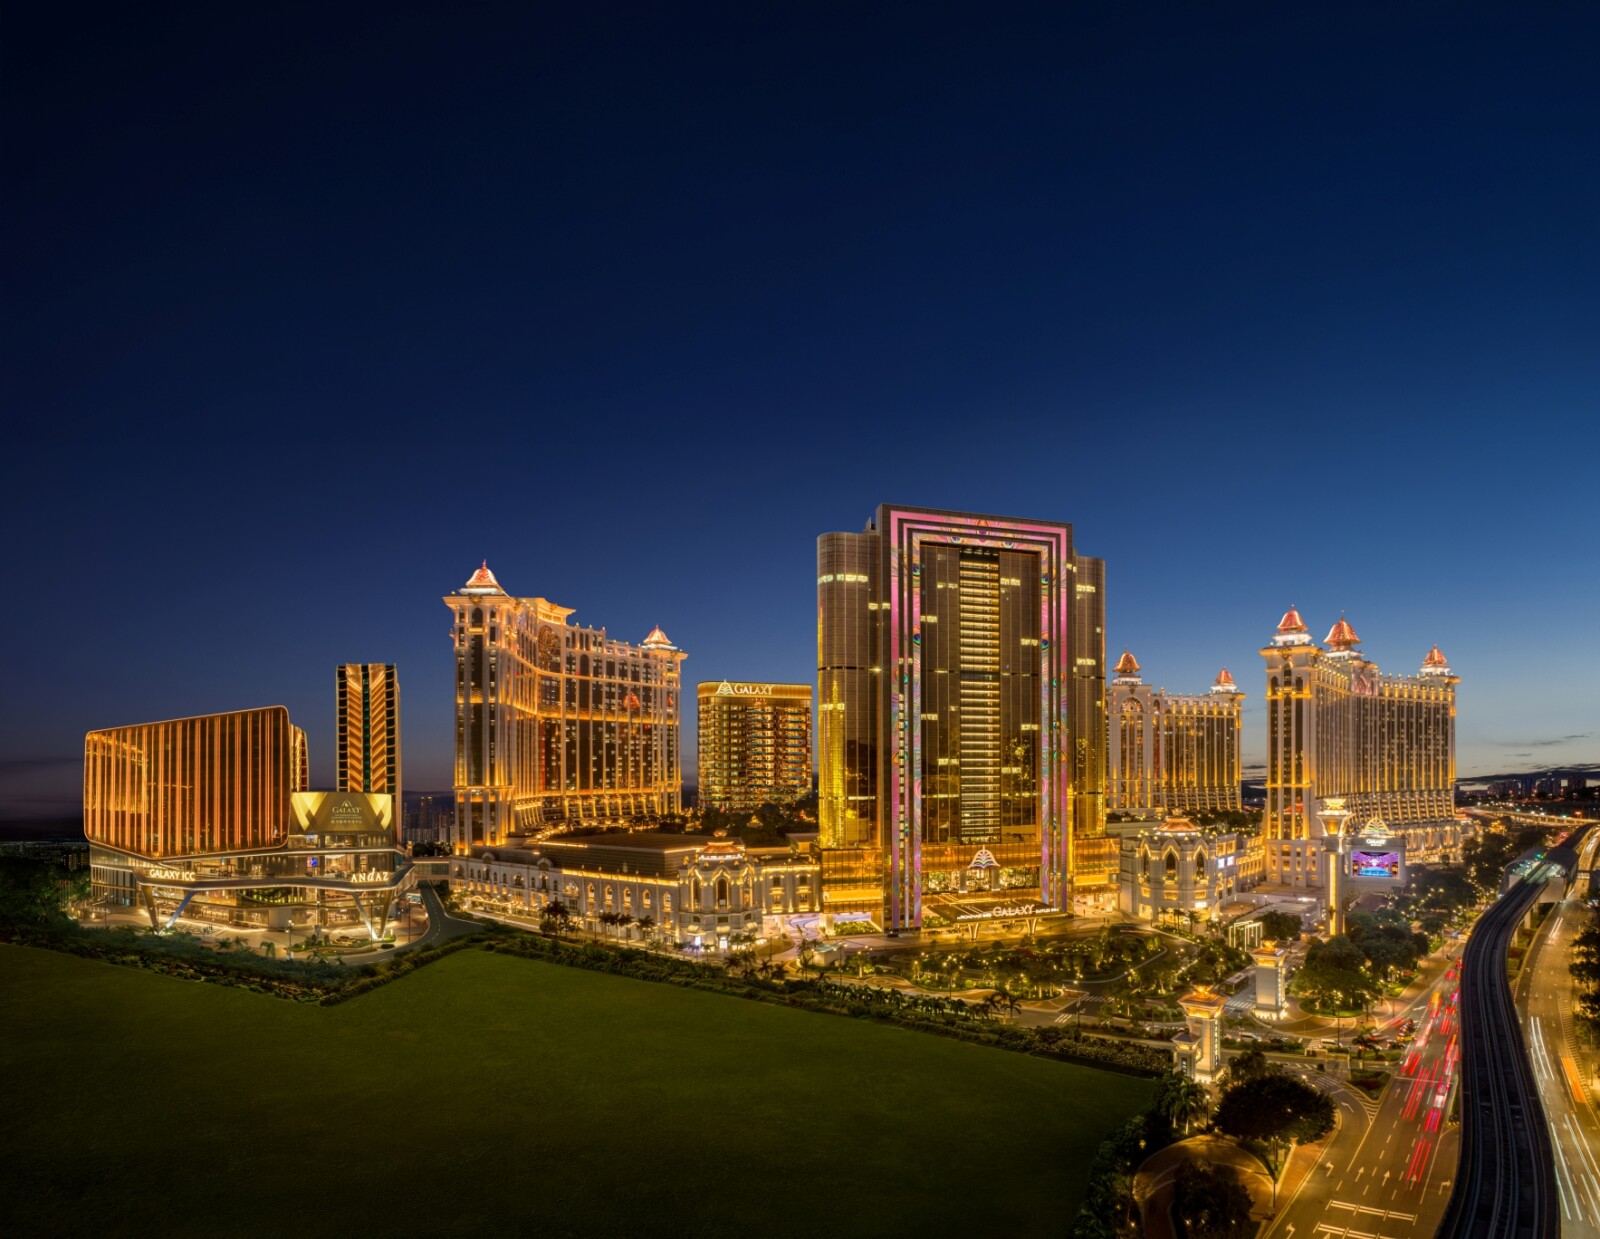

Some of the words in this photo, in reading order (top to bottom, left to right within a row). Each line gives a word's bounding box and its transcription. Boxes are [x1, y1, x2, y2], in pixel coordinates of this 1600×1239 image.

[734, 683, 776, 695] GALAXY
[332, 806, 362, 814] GALAXY
[149, 869, 180, 880] GALAXY
[181, 871, 196, 881] ICC
[993, 904, 1035, 917] GALAXY
